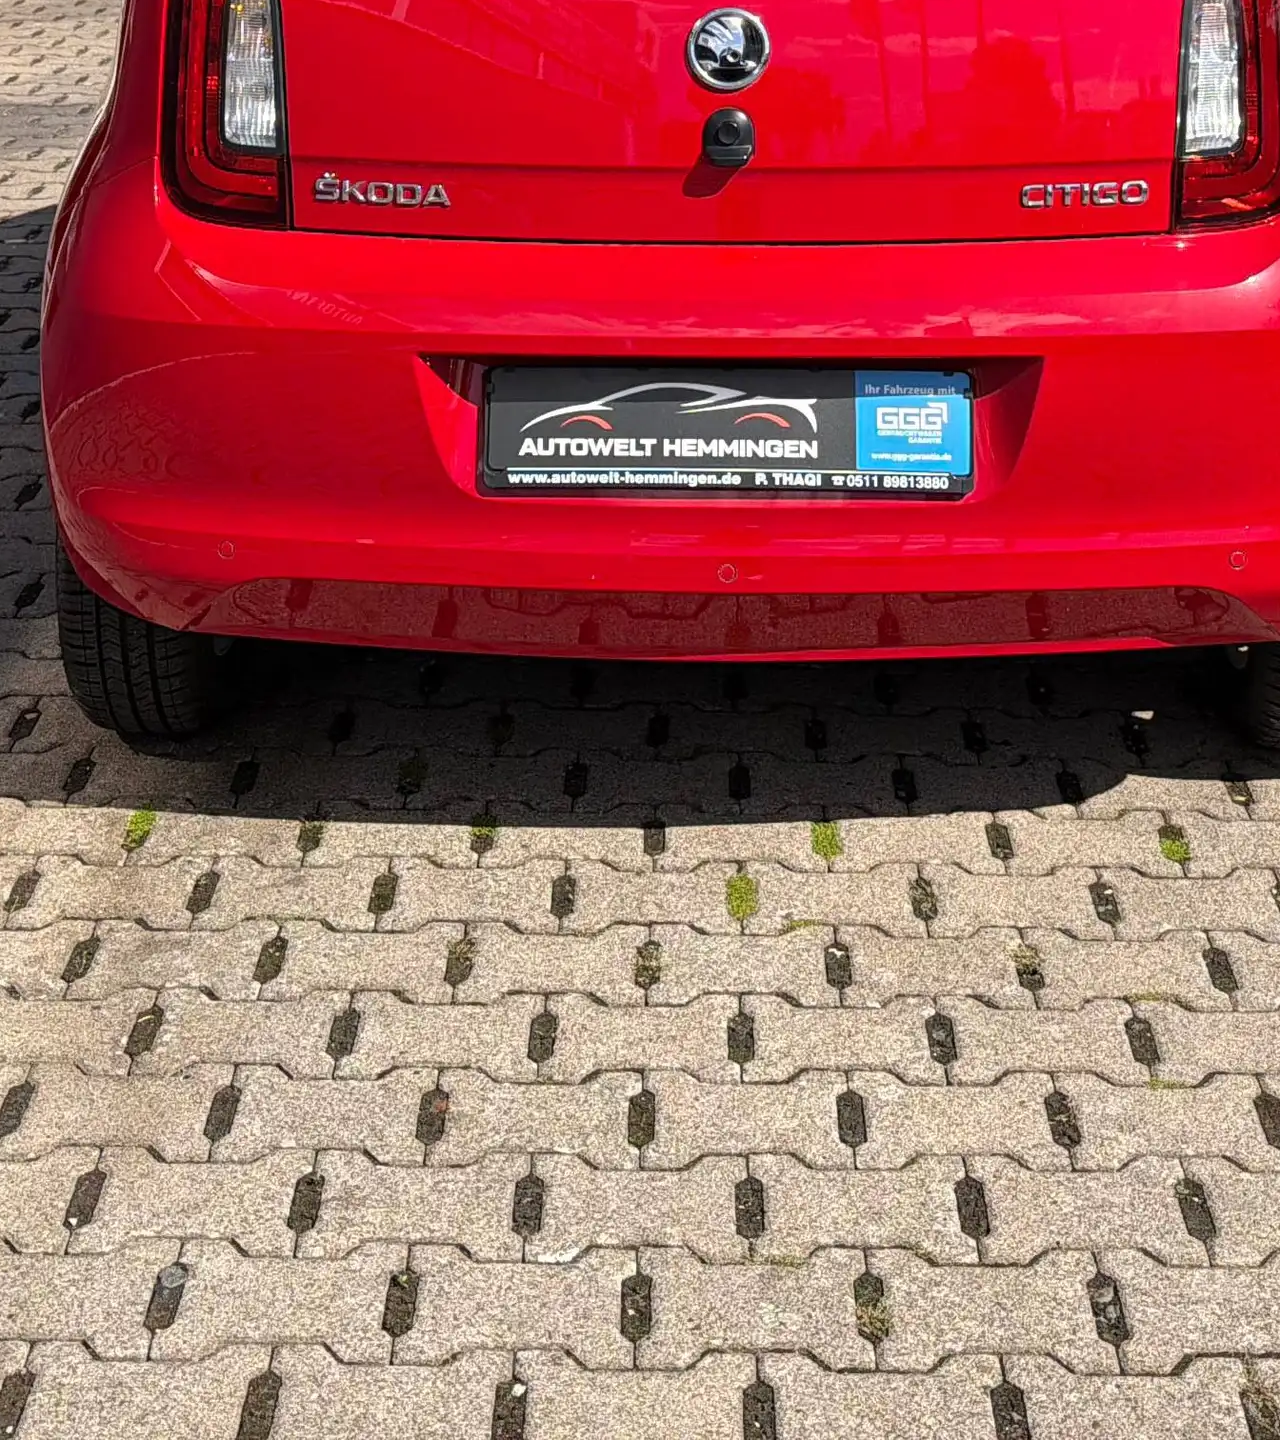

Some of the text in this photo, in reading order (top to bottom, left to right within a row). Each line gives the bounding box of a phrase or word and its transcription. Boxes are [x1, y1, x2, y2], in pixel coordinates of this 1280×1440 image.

[315, 172, 451, 206] ŠKODA
[1021, 180, 1149, 208] CITIGO
[865, 383, 956, 397] Ihr Fahrzeug mit
[876, 407, 942, 431] GGG
[519, 437, 818, 458] AUTOWELT HEMMINGEN
[508, 471, 741, 487] www.autowelt-hemmingen.de
[846, 475, 878, 488] 0511
